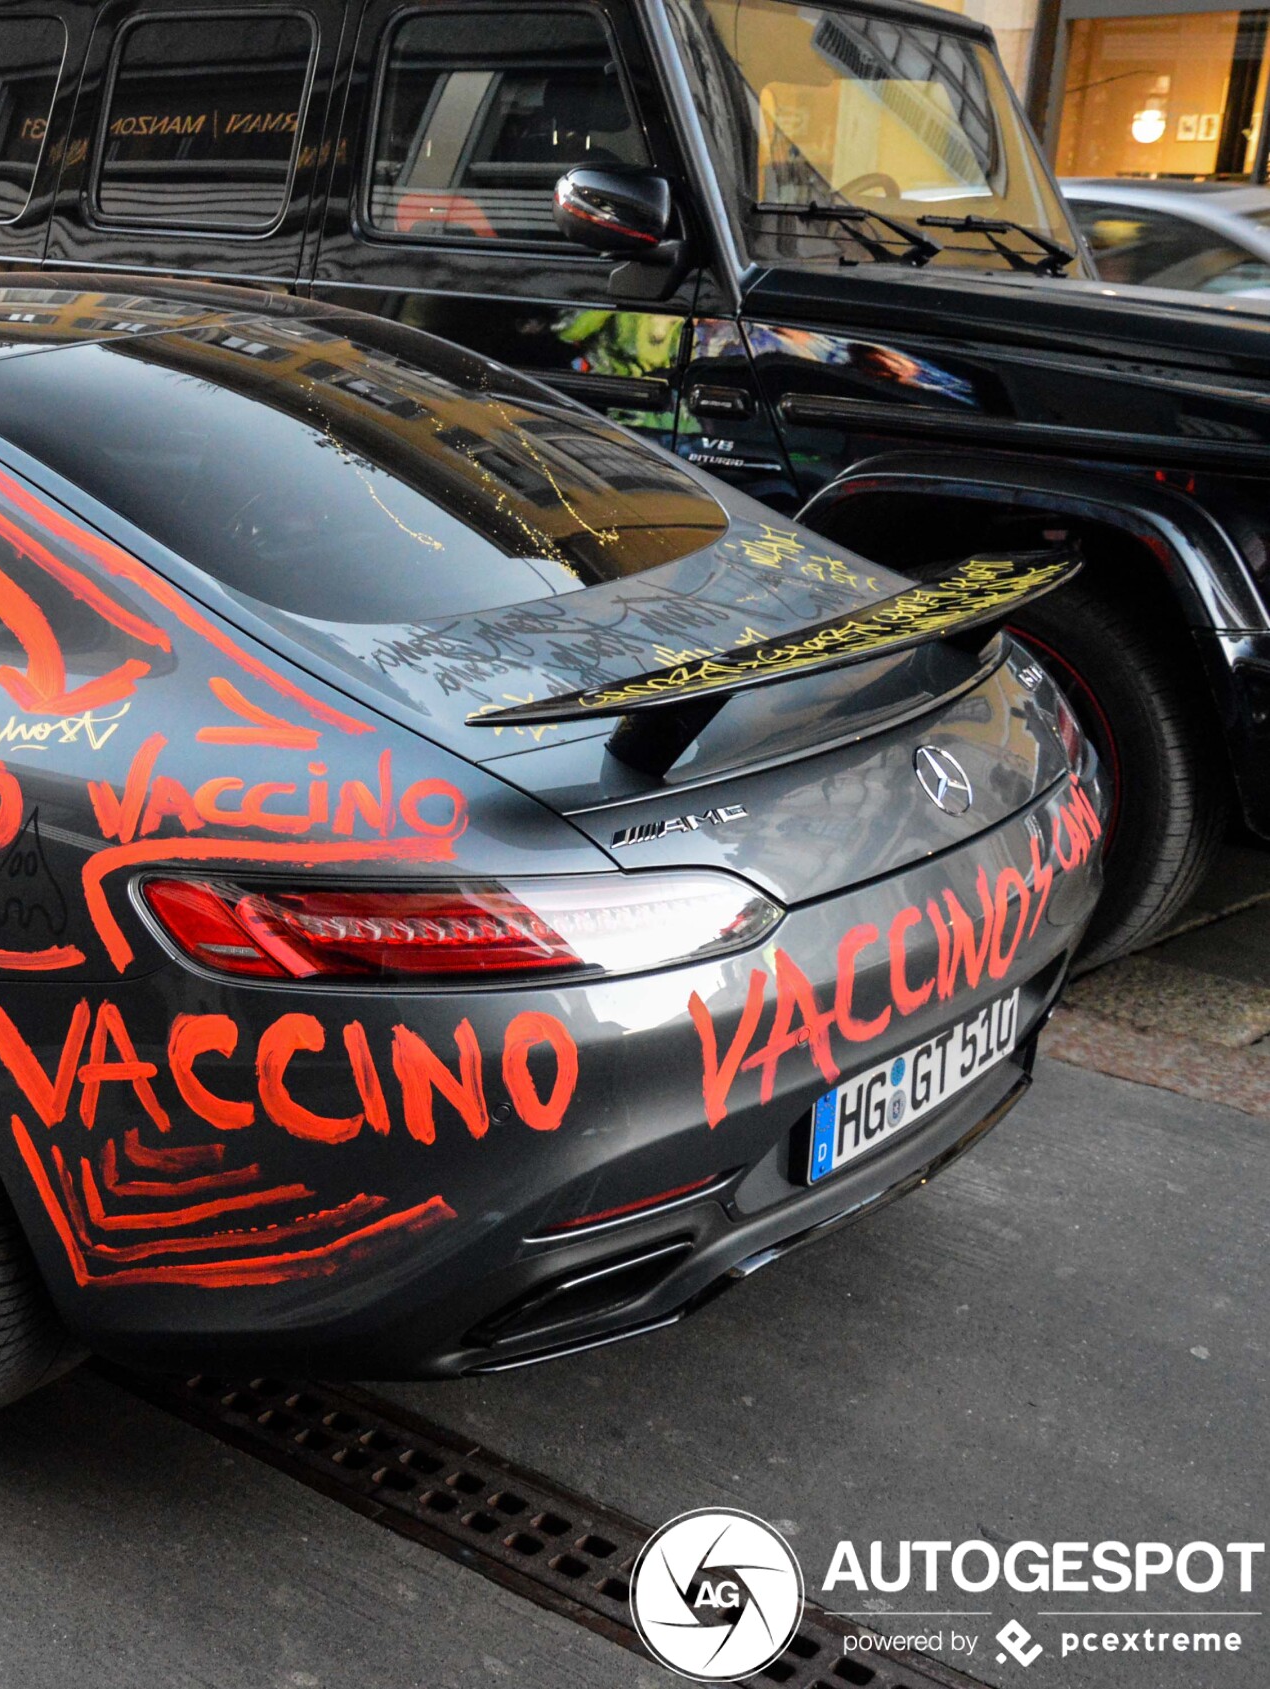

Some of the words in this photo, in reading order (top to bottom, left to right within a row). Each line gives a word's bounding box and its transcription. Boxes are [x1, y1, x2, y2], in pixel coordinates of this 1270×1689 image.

[837, 1071, 887, 1158] HG
[910, 1031, 955, 1112] GT
[817, 1143, 828, 1163] D
